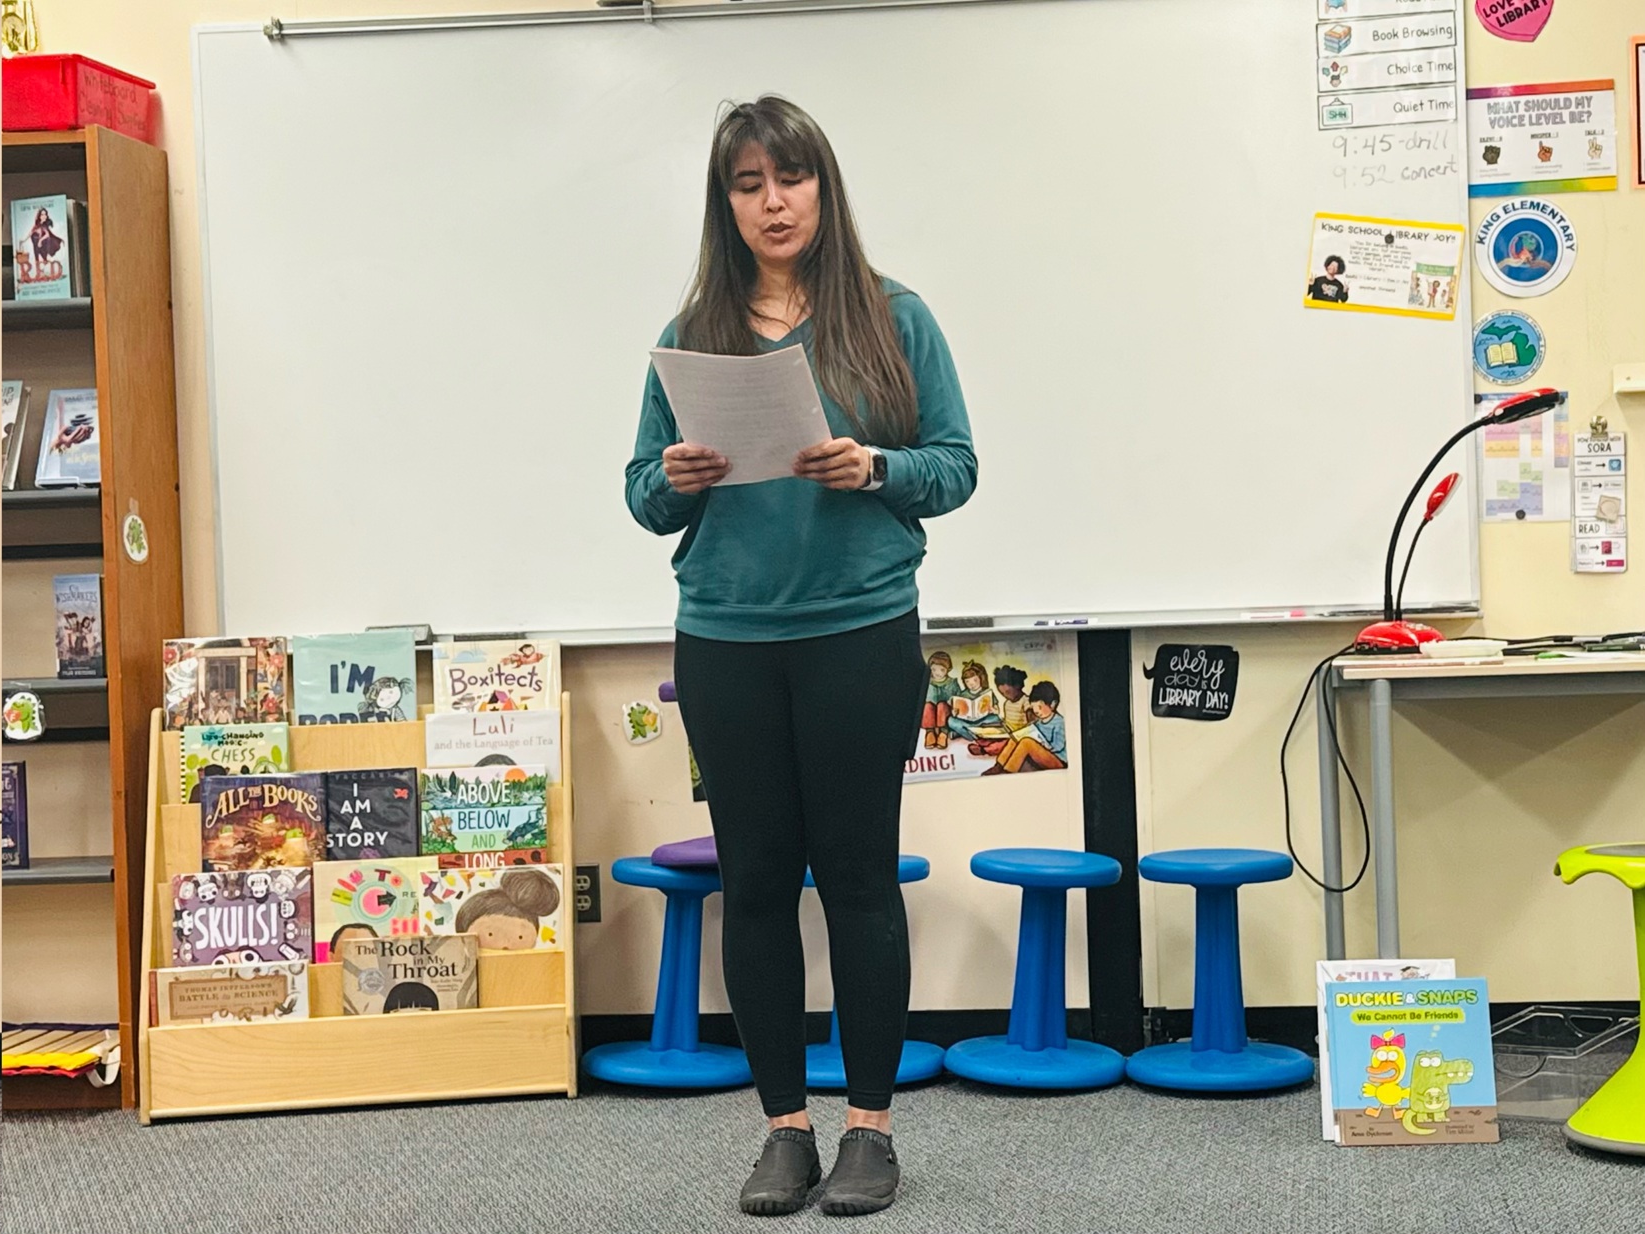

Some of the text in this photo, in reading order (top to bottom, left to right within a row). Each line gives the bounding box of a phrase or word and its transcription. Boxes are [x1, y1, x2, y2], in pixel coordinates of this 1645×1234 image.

[1372, 26, 1453, 42] Book Browsing
[1387, 61, 1454, 76] Choice Time
[1524, 97, 1573, 113] SHOULD
[1529, 112, 1566, 127] LEVEL
[1476, 200, 1575, 252] KING ELEMENTARY
[1587, 441, 1612, 453] SORA
[330, 661, 375, 694] I'M
[1170, 648, 1225, 689] every
[449, 664, 543, 696] Boxitects
[1158, 687, 1228, 709] LIBRARY DAY!
[211, 748, 255, 762] CHESS
[206, 784, 321, 828] ALL BOOKS
[458, 810, 510, 830] BELOW
[465, 851, 505, 869] LONG
[193, 902, 278, 949] SKULLS!
[1335, 989, 1478, 1007] DUCKIE & SNAPS
